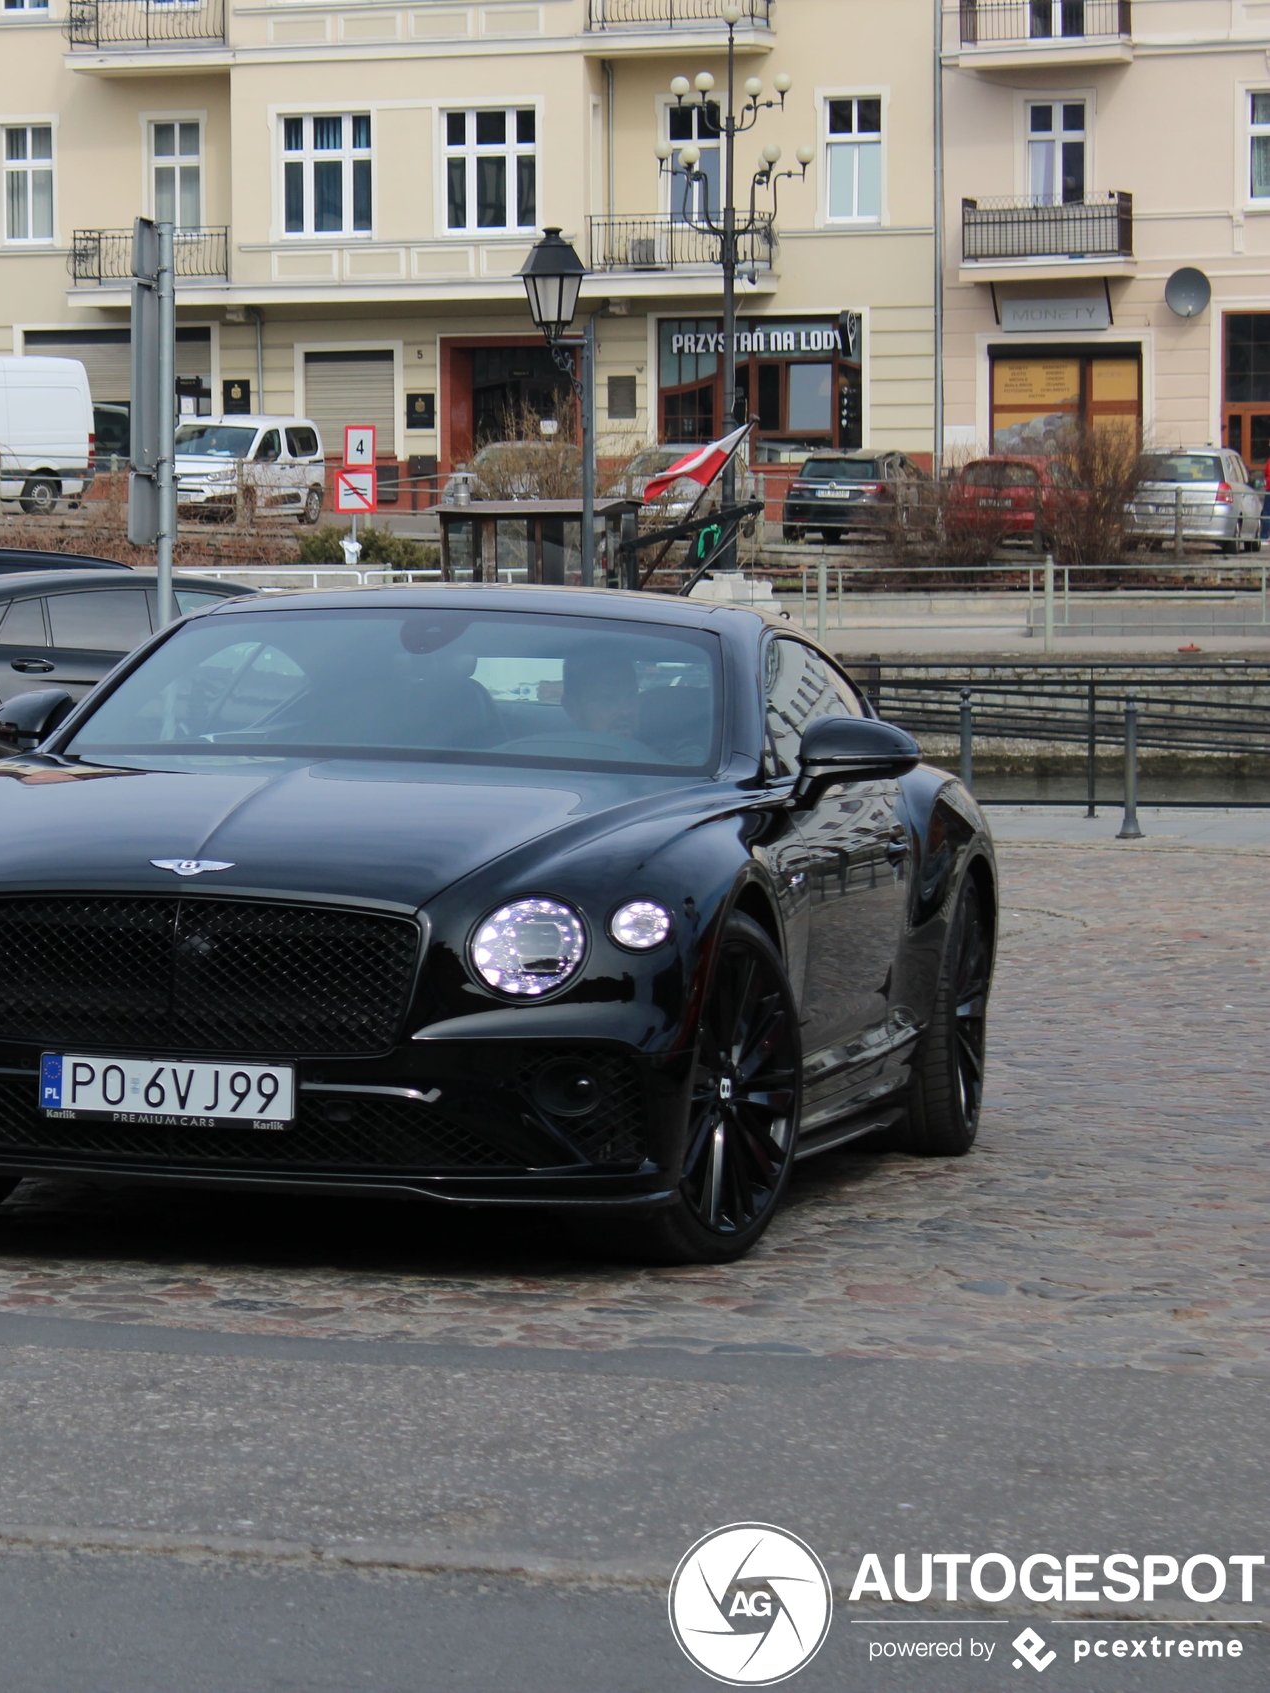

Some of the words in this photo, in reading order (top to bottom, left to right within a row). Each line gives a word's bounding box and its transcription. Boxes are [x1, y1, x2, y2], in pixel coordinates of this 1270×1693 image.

[1013, 307, 1096, 321] MONETY
[672, 327, 765, 354] PRZYSTAŃ
[770, 331, 795, 352] NA
[417, 350, 423, 360] 5
[356, 438, 364, 455] 4
[44, 1087, 59, 1099] PL
[144, 1067, 279, 1114] 6VJ99
[46, 1109, 76, 1119] Karlik
[113, 1113, 177, 1126] PREMIUM
[180, 1117, 215, 1127] CARS
[253, 1120, 284, 1131] Karlik
